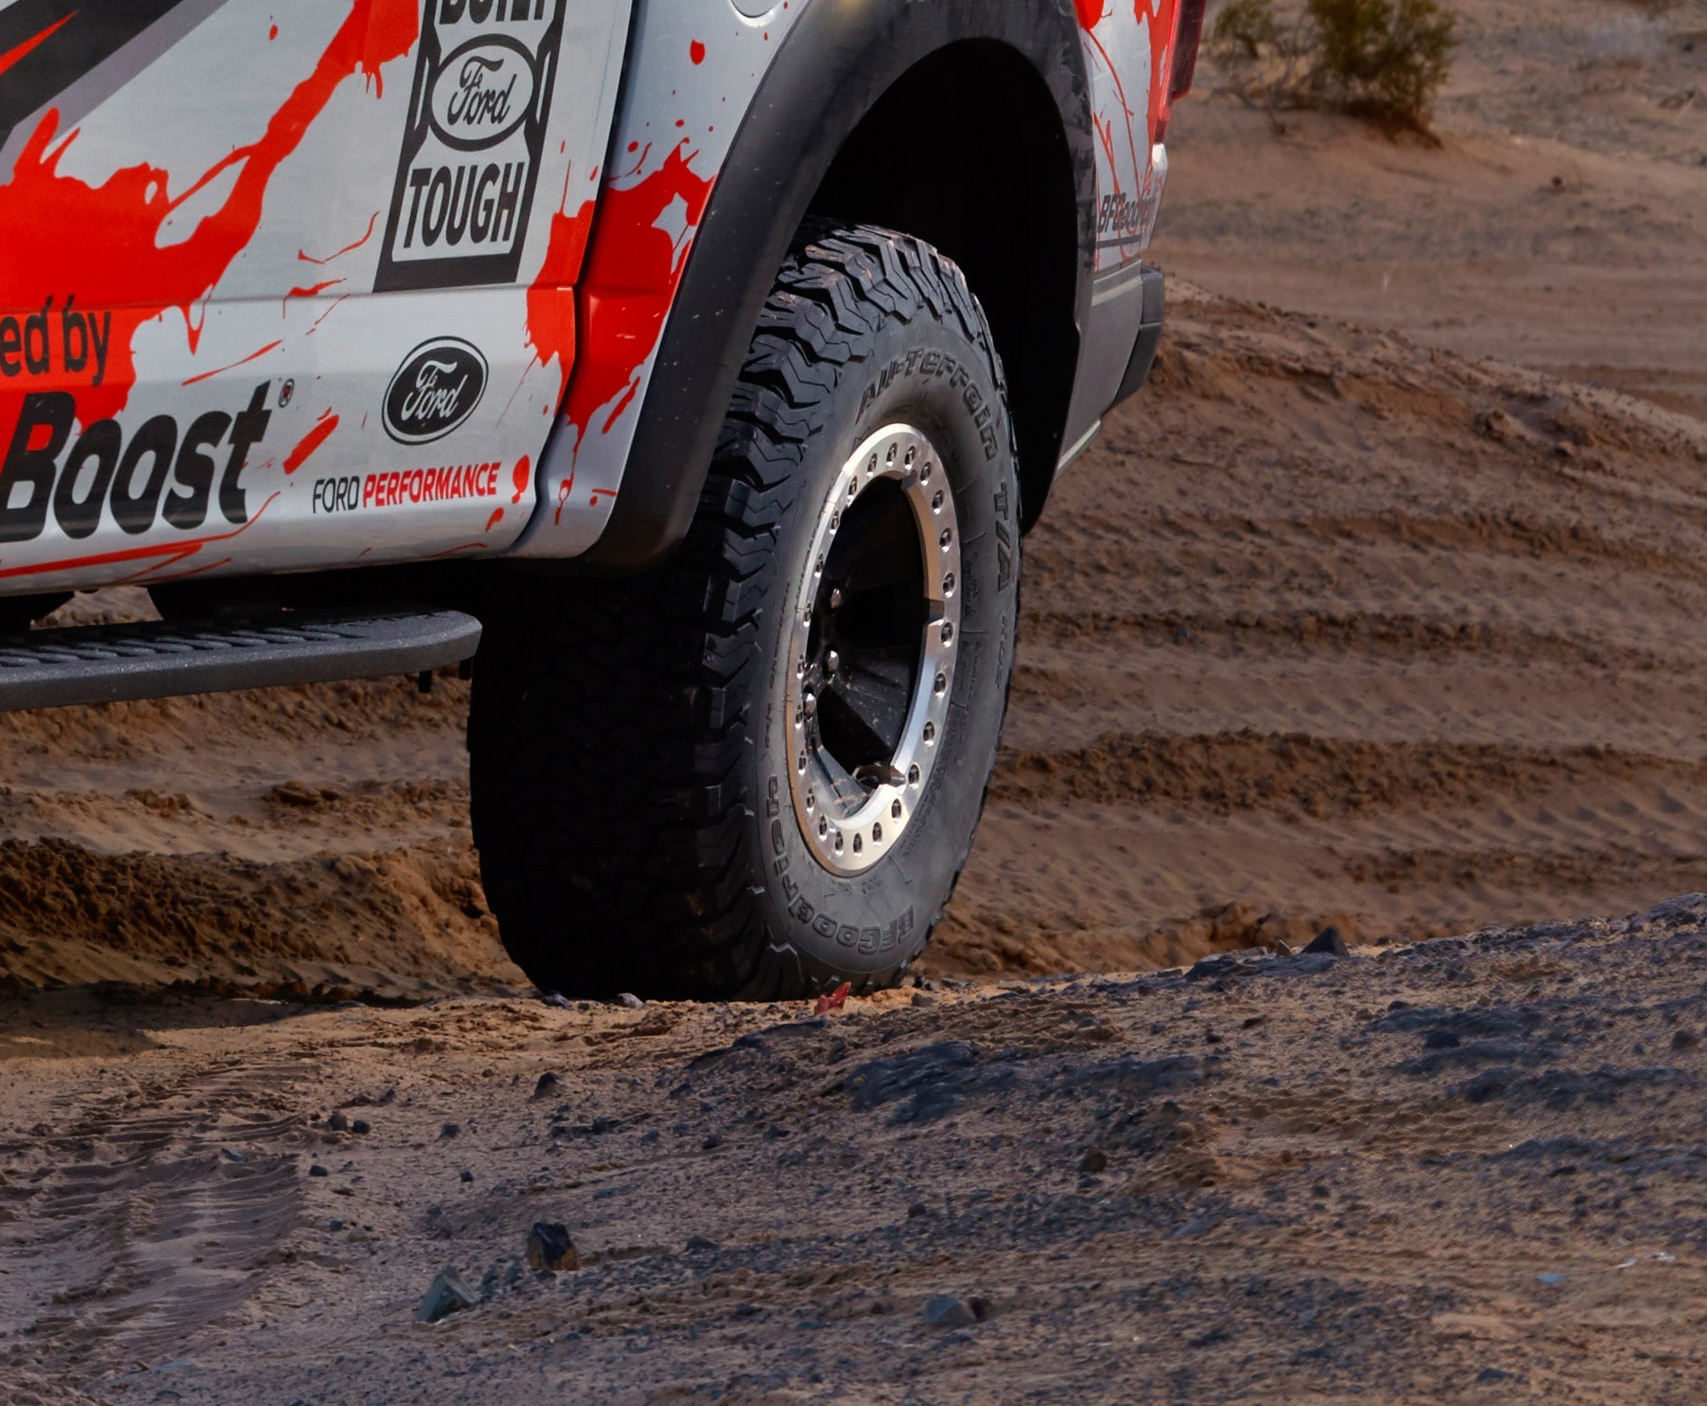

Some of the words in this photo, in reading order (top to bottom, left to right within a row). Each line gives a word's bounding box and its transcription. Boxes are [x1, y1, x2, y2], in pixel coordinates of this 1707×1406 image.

[447, 54, 512, 129] Ford
[403, 161, 525, 249] TOUGH
[61, 294, 112, 388] by
[401, 358, 467, 422] Ford
[312, 475, 360, 514] FORD
[362, 461, 502, 508] PERFORMANCE
